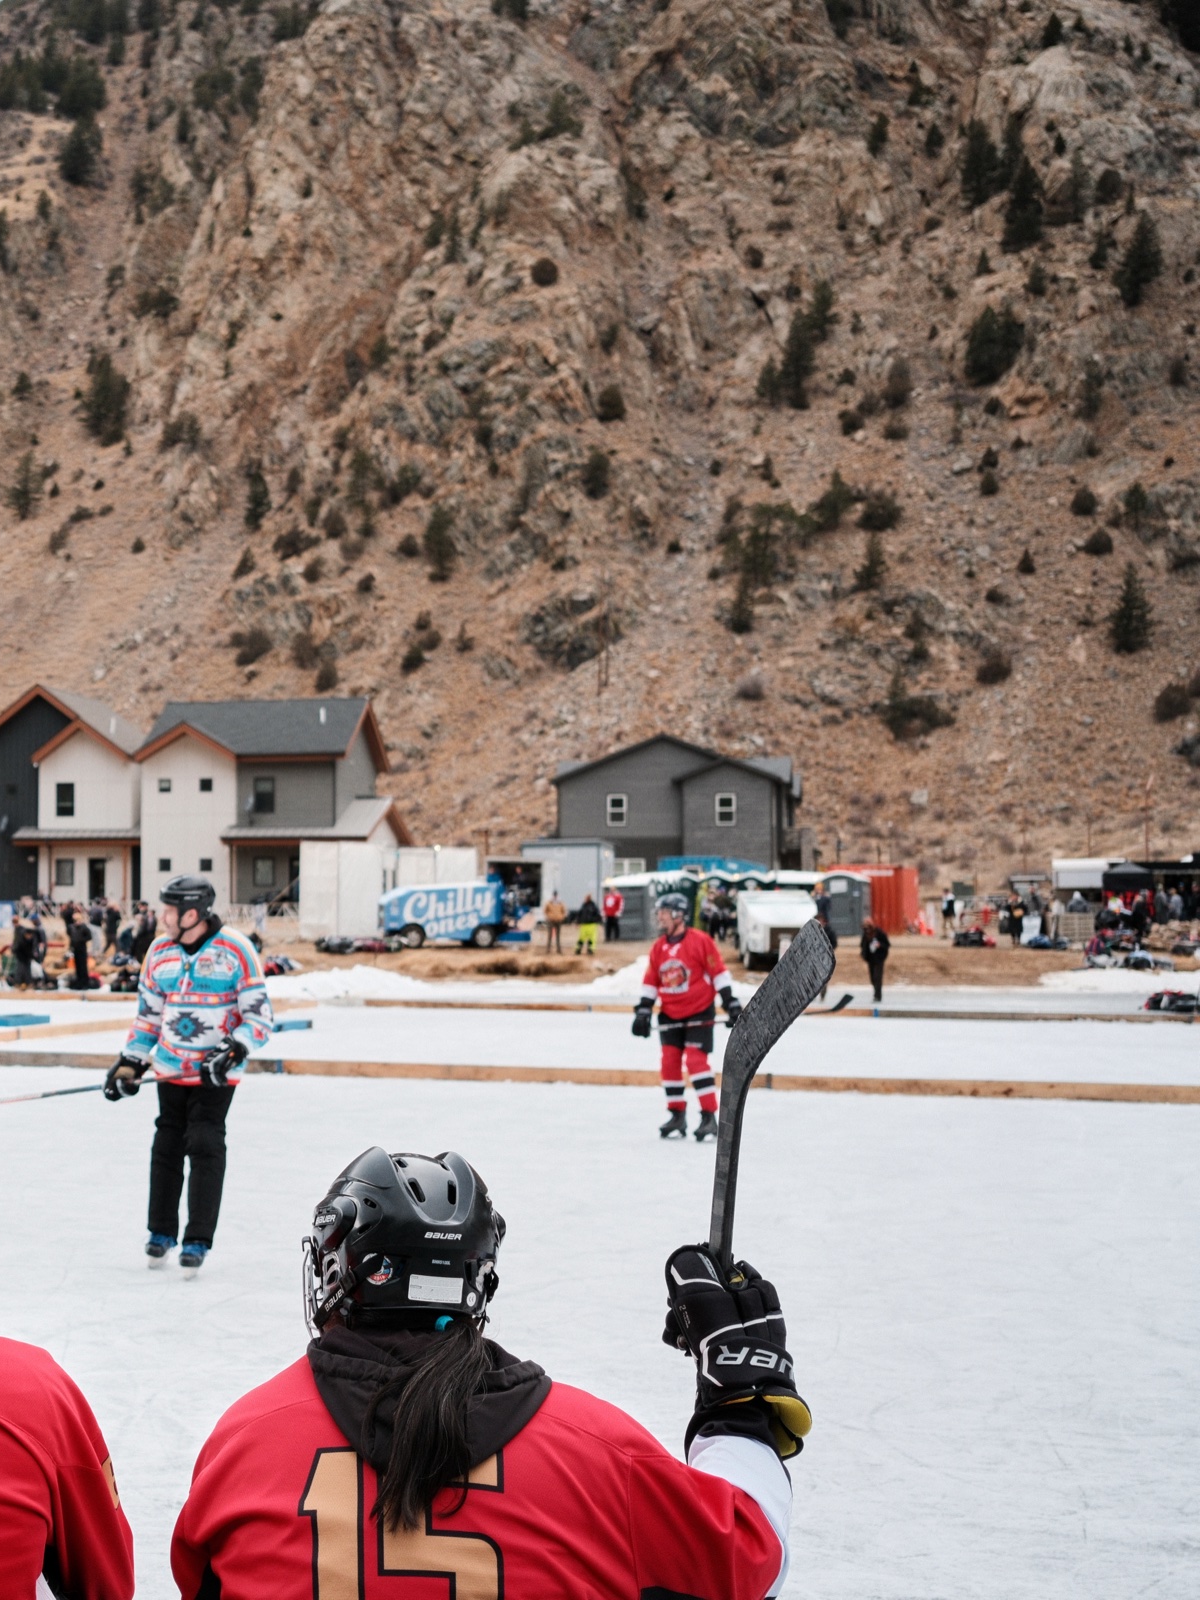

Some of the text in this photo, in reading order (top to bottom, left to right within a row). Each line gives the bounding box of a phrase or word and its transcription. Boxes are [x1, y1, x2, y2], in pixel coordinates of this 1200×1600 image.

[403, 887, 495, 925] Chilly
[425, 911, 480, 936] ones
[315, 1213, 336, 1224] BAUER
[424, 1231, 462, 1241] BAUER
[297, 1446, 504, 1600] 15
